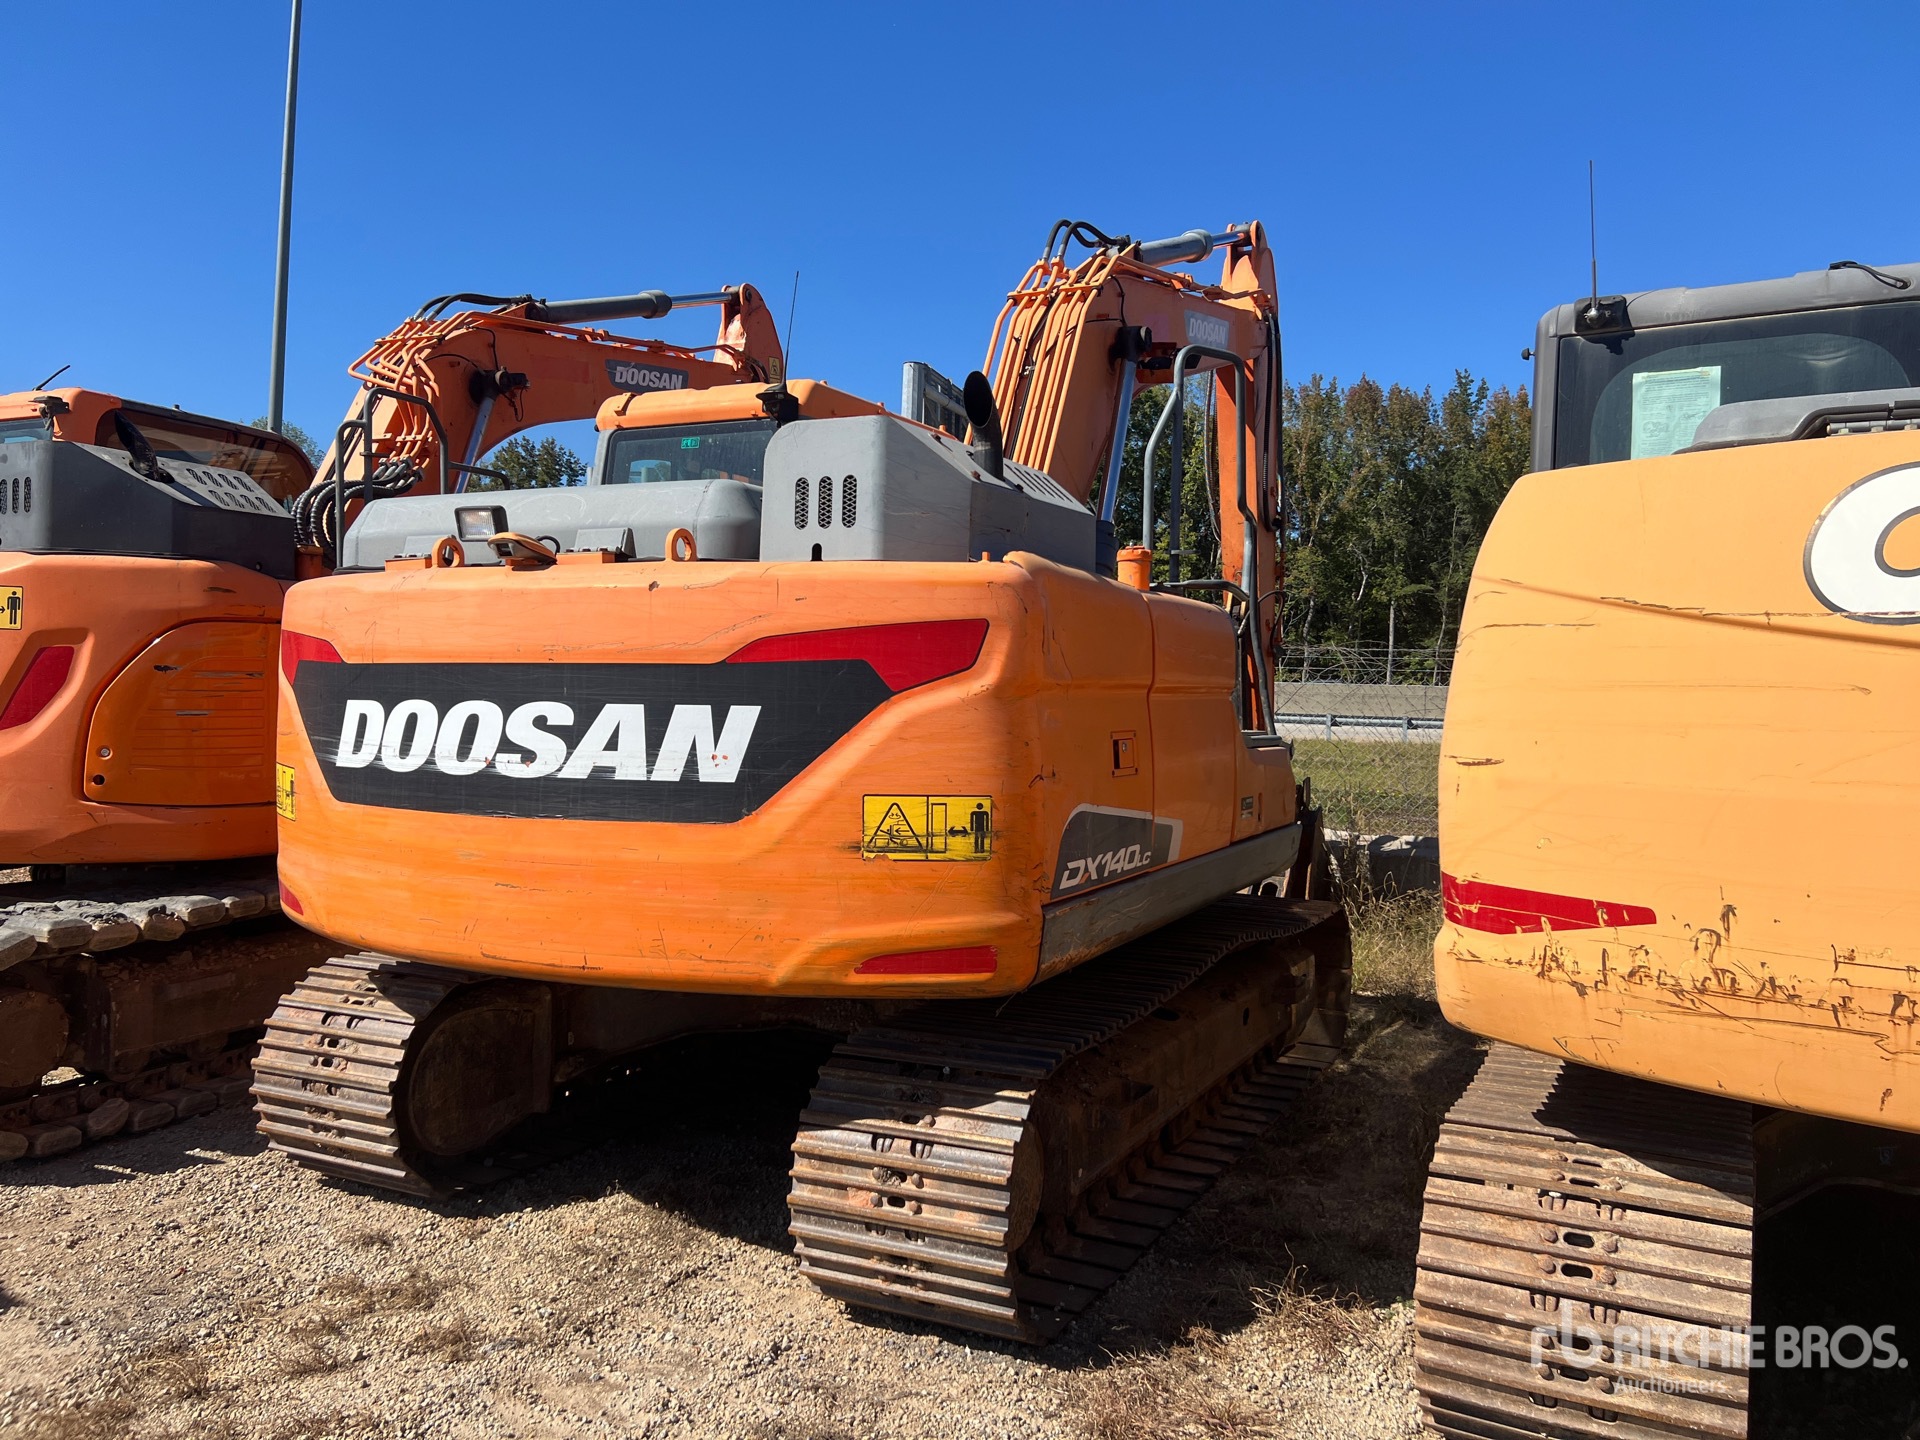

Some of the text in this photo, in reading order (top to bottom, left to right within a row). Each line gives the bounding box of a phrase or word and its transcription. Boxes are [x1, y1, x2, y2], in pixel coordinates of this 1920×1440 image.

[1189, 318, 1226, 345] DOOSAN
[614, 366, 683, 390] DOOSAN
[335, 699, 762, 783] DOOSAN
